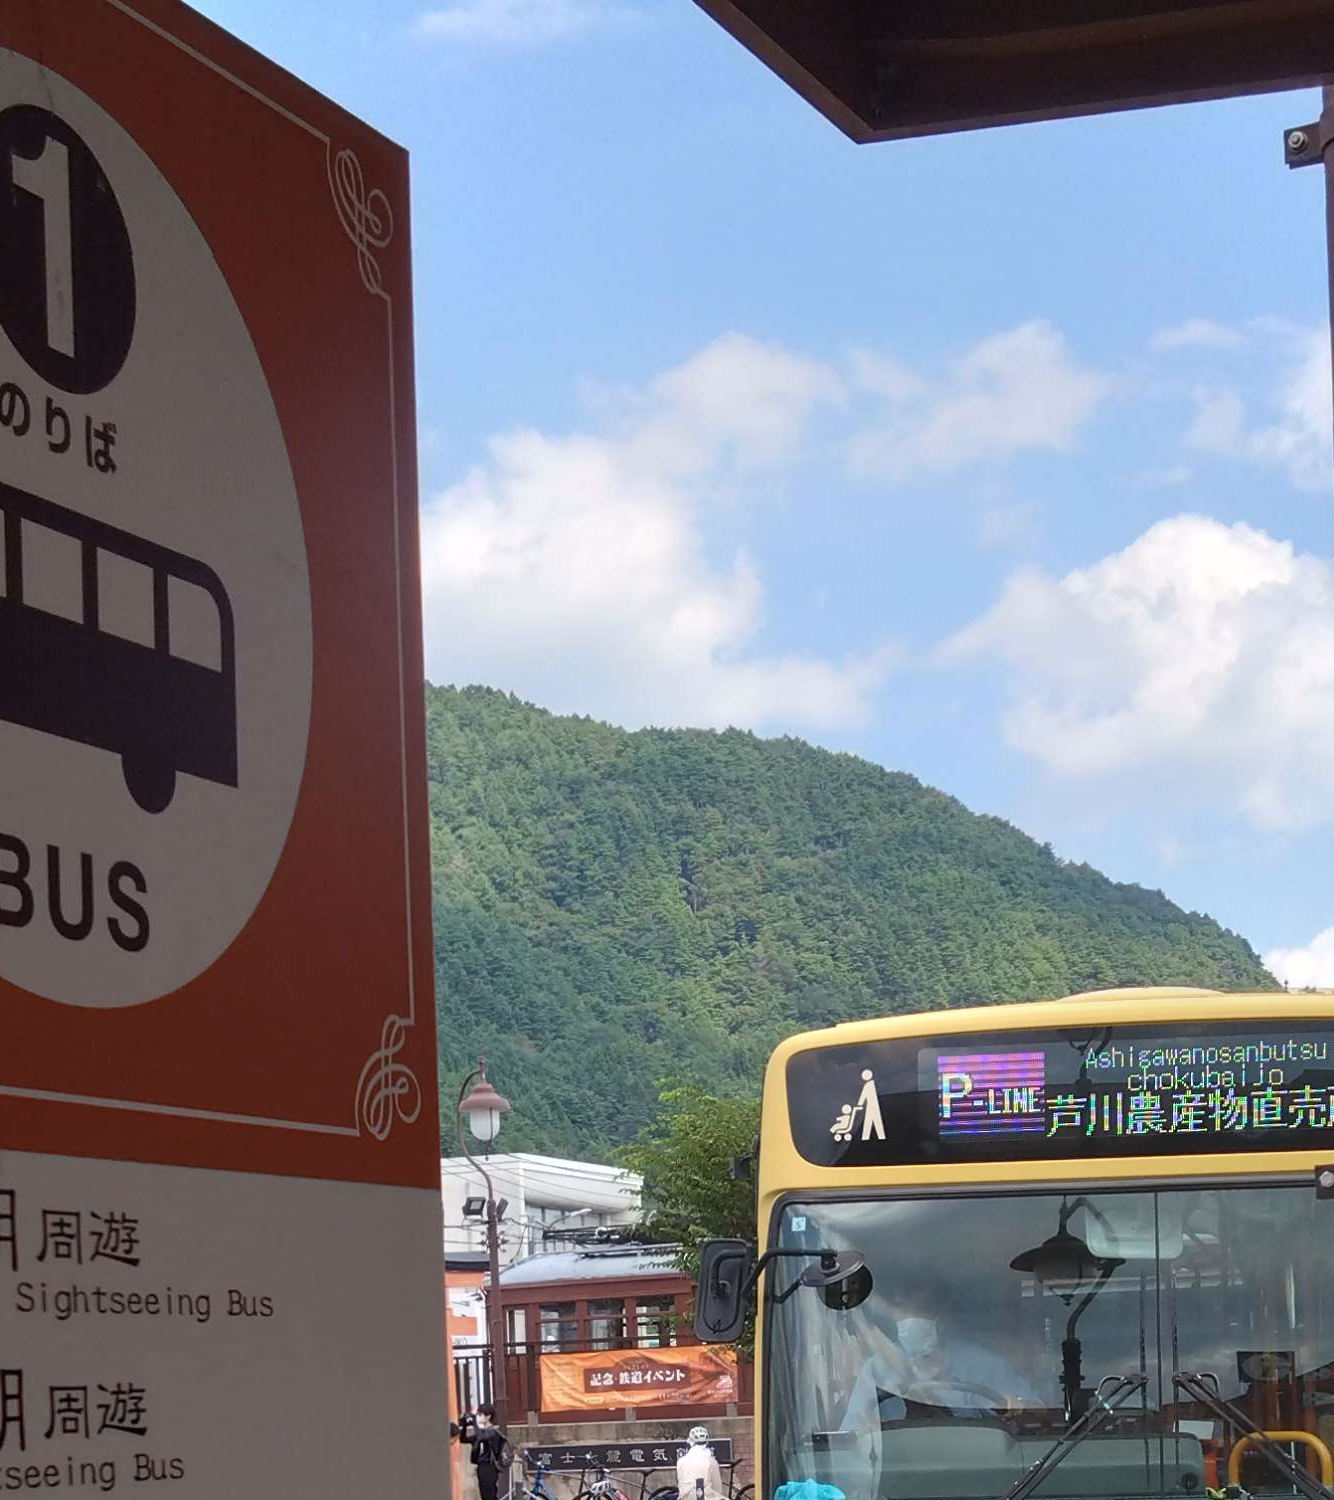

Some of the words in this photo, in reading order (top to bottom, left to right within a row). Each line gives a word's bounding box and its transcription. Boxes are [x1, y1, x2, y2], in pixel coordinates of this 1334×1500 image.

[1085, 1040, 1328, 1070] Ashigawanosanbutsu
[1127, 1065, 1285, 1091] chokubaijo
[15, 1281, 212, 1322] Sightseeing
[227, 1288, 275, 1319] Bus
[134, 1453, 185, 1484] Bus
